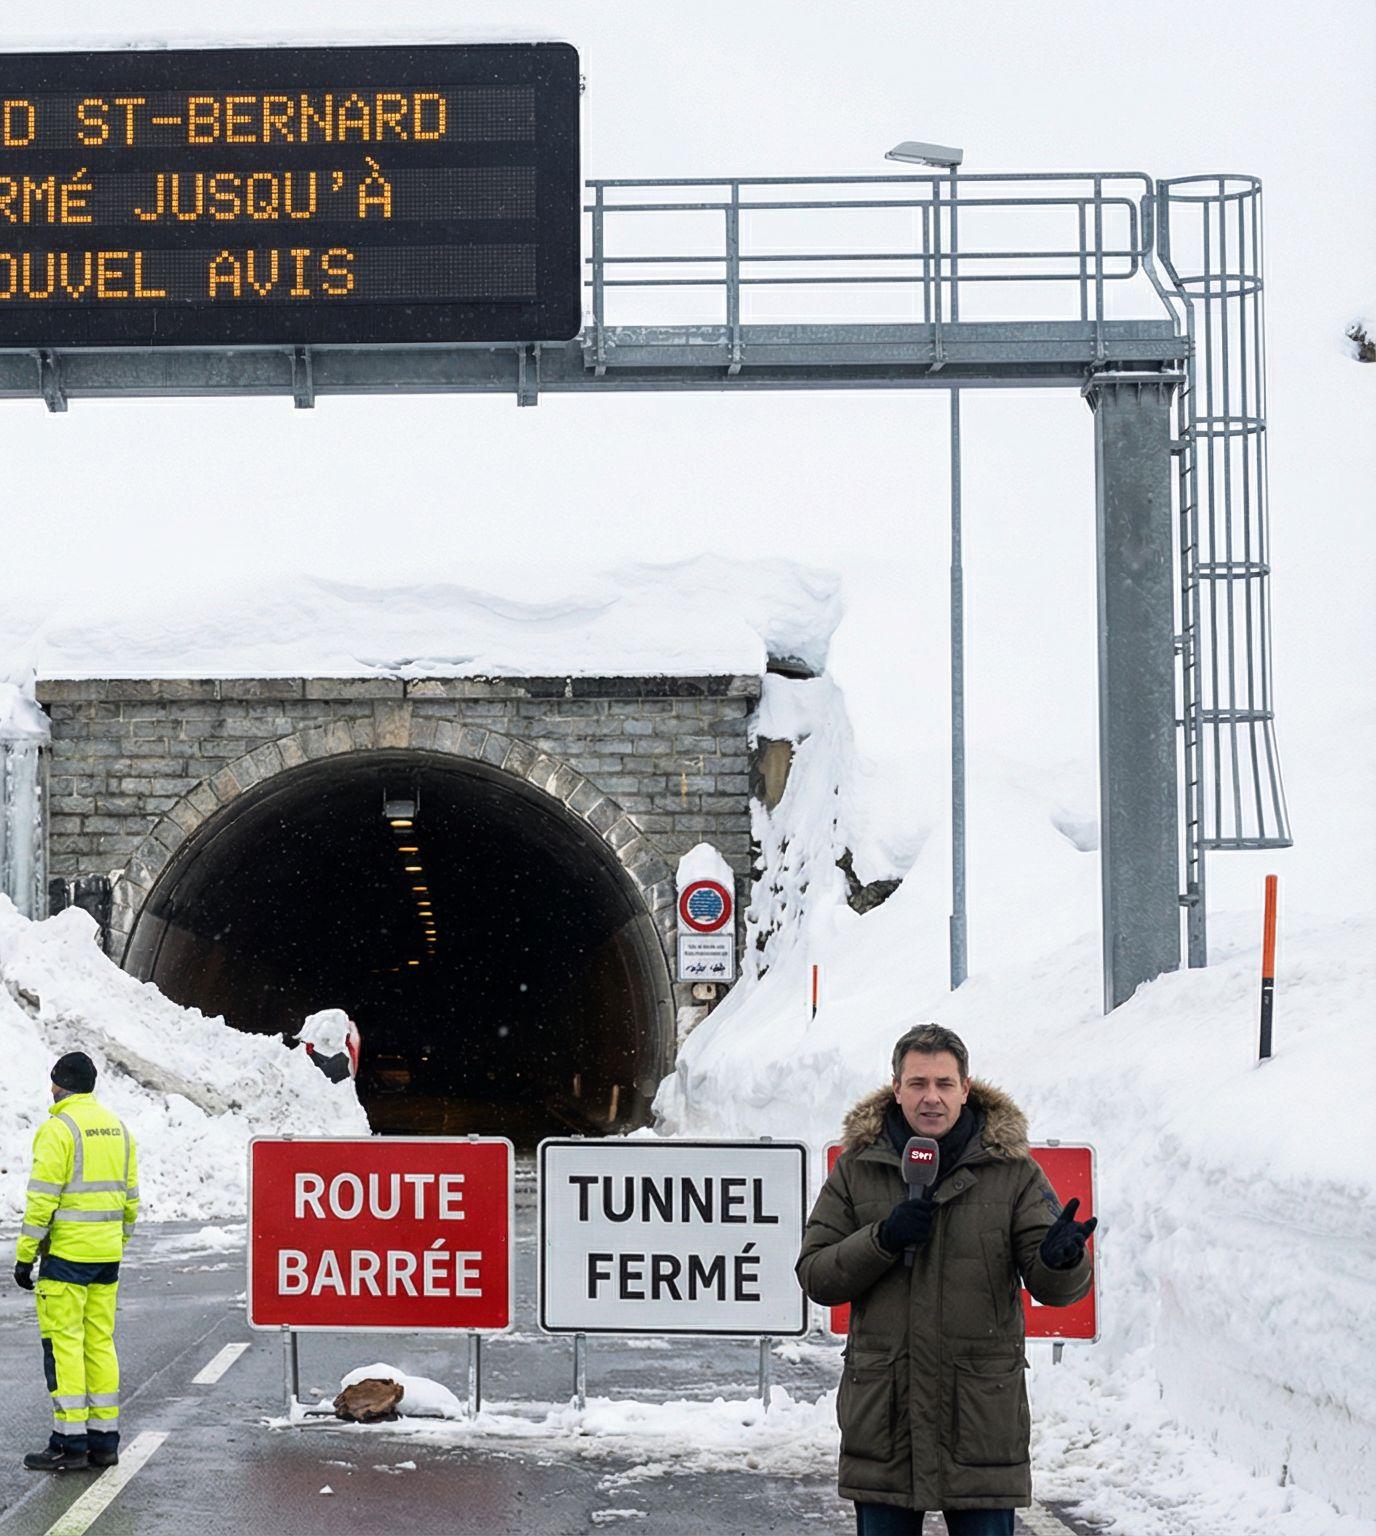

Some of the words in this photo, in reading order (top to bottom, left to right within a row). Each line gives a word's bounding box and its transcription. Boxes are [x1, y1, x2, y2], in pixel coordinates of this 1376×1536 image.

[77, 93, 446, 146] ST-BERNARD
[134, 156, 392, 221] JUSQU'À
[209, 247, 354, 297] AVIS
[295, 1172, 466, 1220] ROUTE
[568, 1175, 779, 1224] TUNNEL
[278, 1238, 482, 1297] BARRÉE
[588, 1242, 761, 1302] FERMÉ
